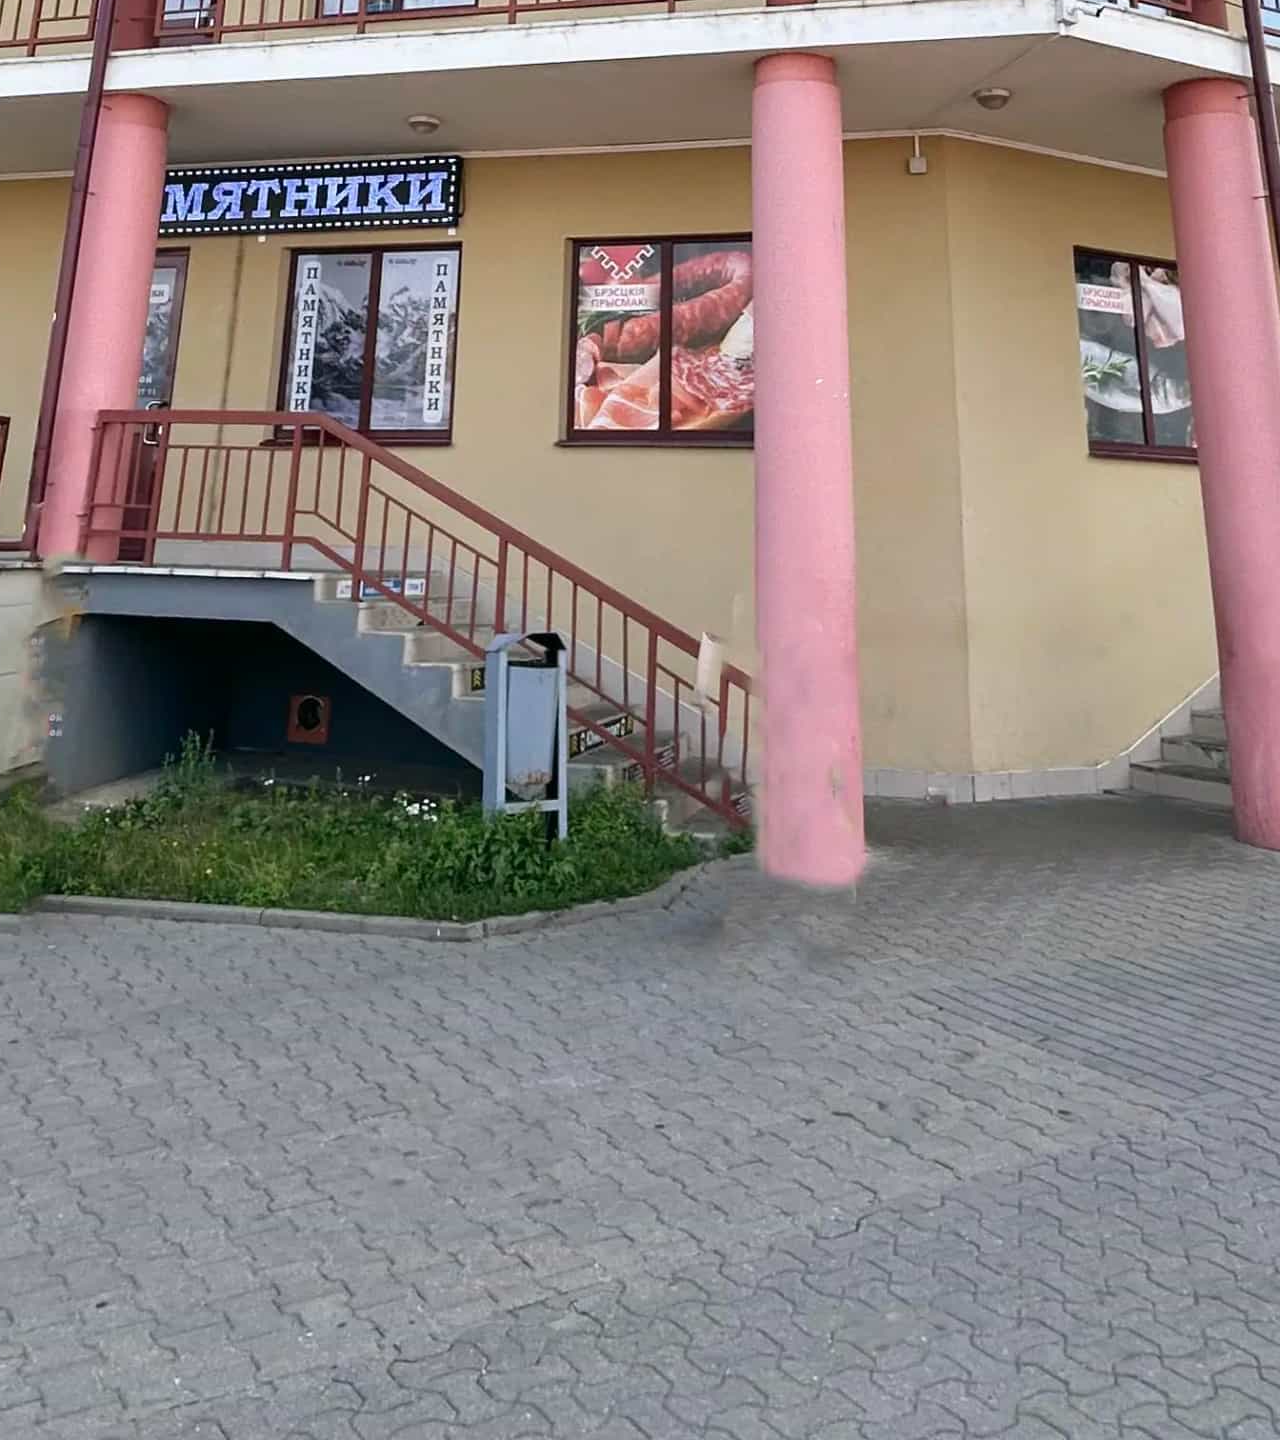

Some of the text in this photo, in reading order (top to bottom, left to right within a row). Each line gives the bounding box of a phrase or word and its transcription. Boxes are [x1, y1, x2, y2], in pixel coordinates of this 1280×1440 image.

[159, 171, 449, 222] МЯТНИКИ
[293, 266, 319, 411] ПАМЯТНИКИ
[426, 263, 449, 411] ПАМЯТНИКИ
